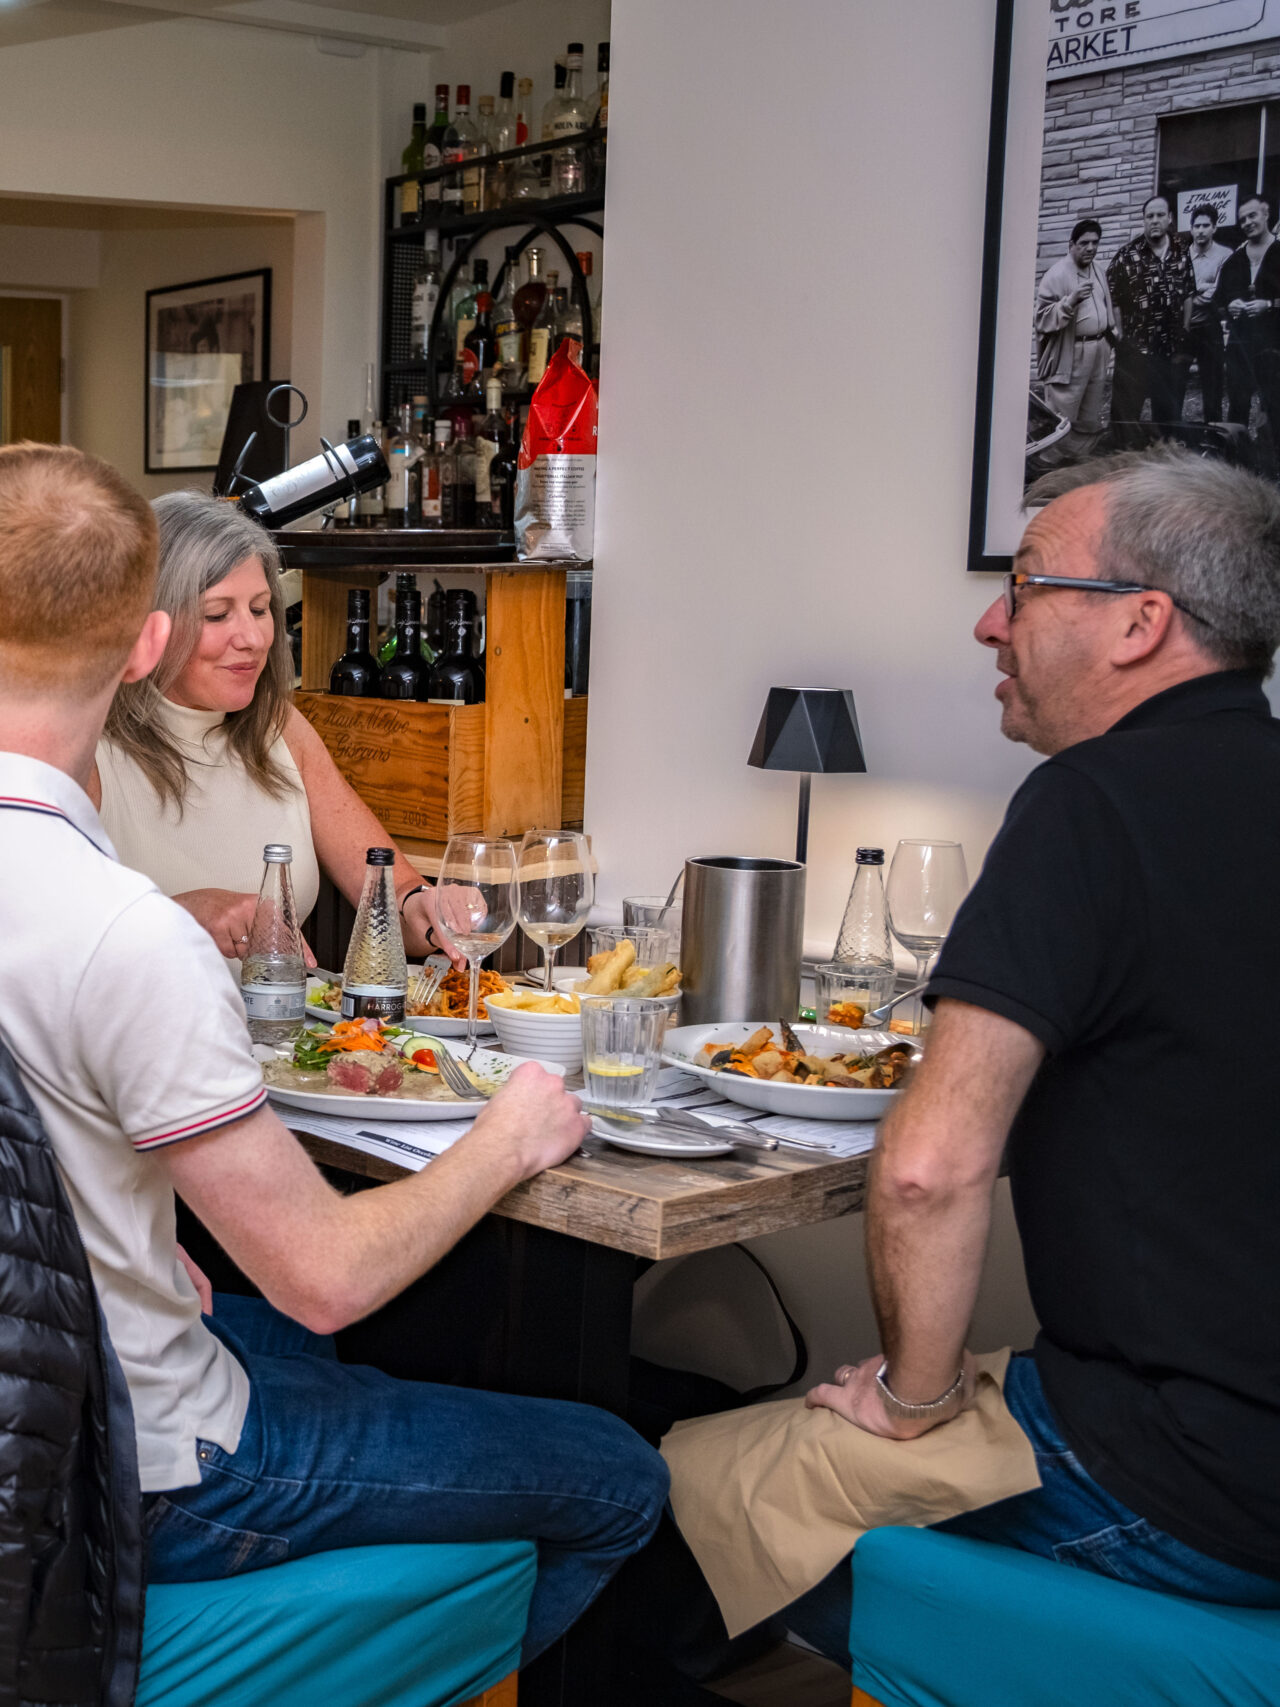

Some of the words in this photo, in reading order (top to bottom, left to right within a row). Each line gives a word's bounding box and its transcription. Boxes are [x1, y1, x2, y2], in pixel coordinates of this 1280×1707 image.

[1054, 1, 1140, 33] TORE
[1047, 25, 1137, 67] ARKET
[1186, 190, 1230, 204] ITALIAN
